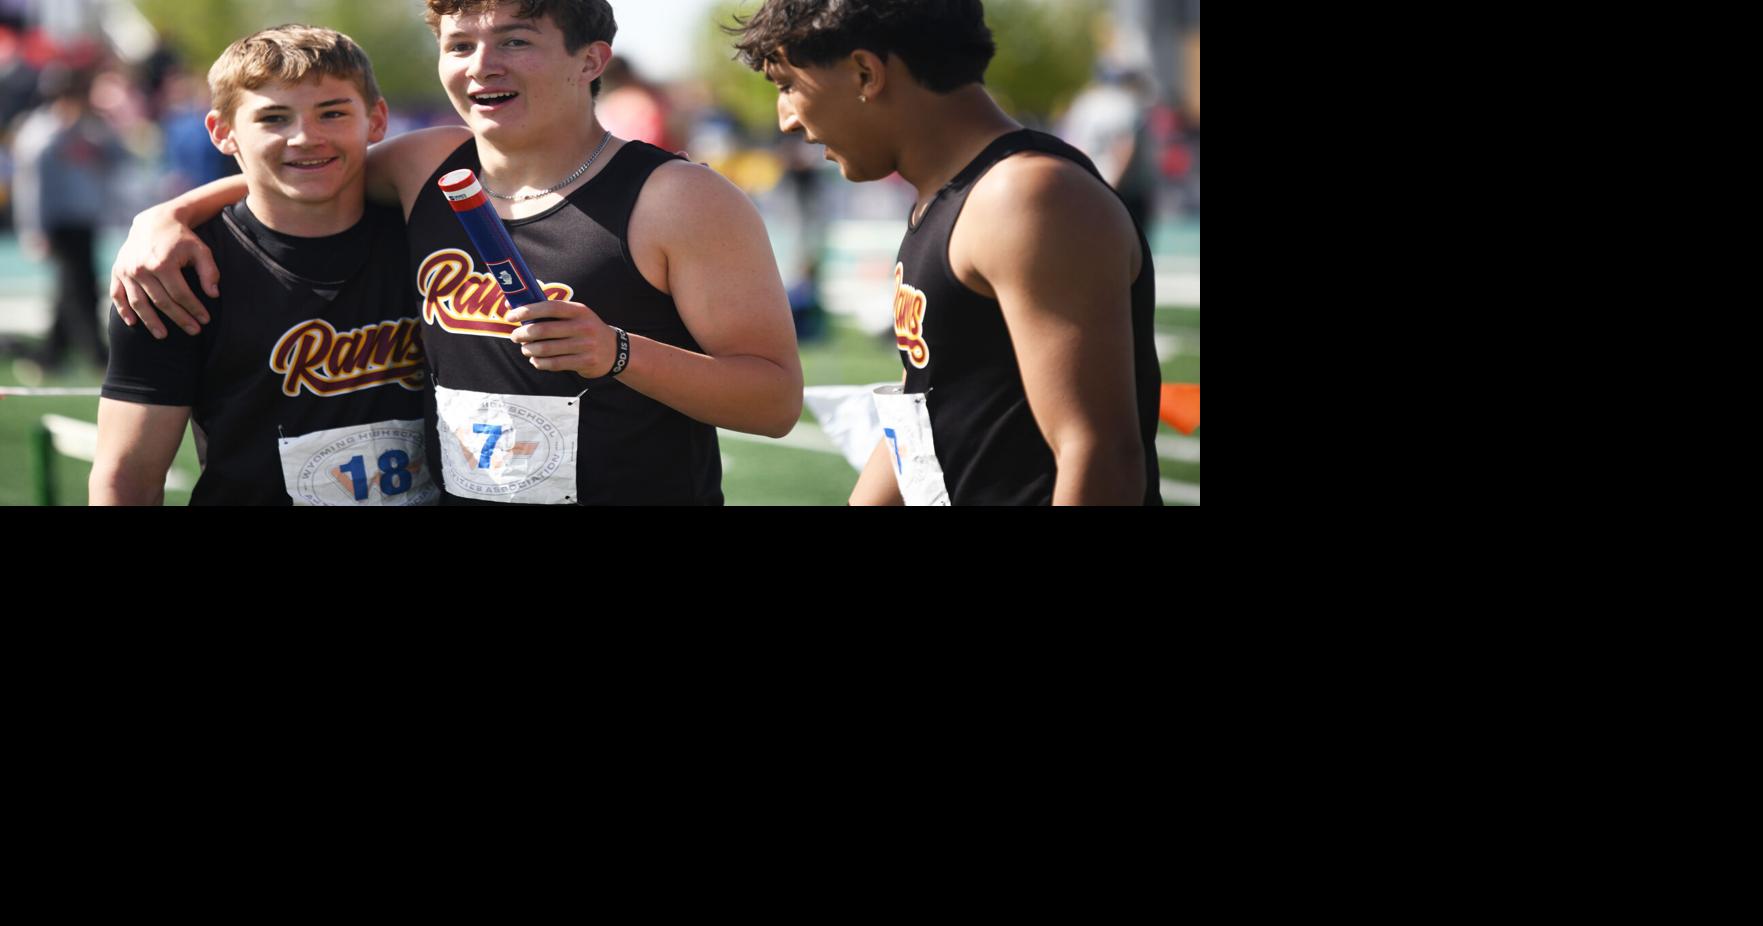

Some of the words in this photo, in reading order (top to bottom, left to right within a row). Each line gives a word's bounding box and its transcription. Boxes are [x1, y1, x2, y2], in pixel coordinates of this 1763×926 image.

[620, 341, 628, 351] IS
[508, 406, 555, 438] SCHOOL
[302, 437, 356, 480] WYOMING
[472, 423, 503, 469] 7
[339, 449, 412, 501] 18
